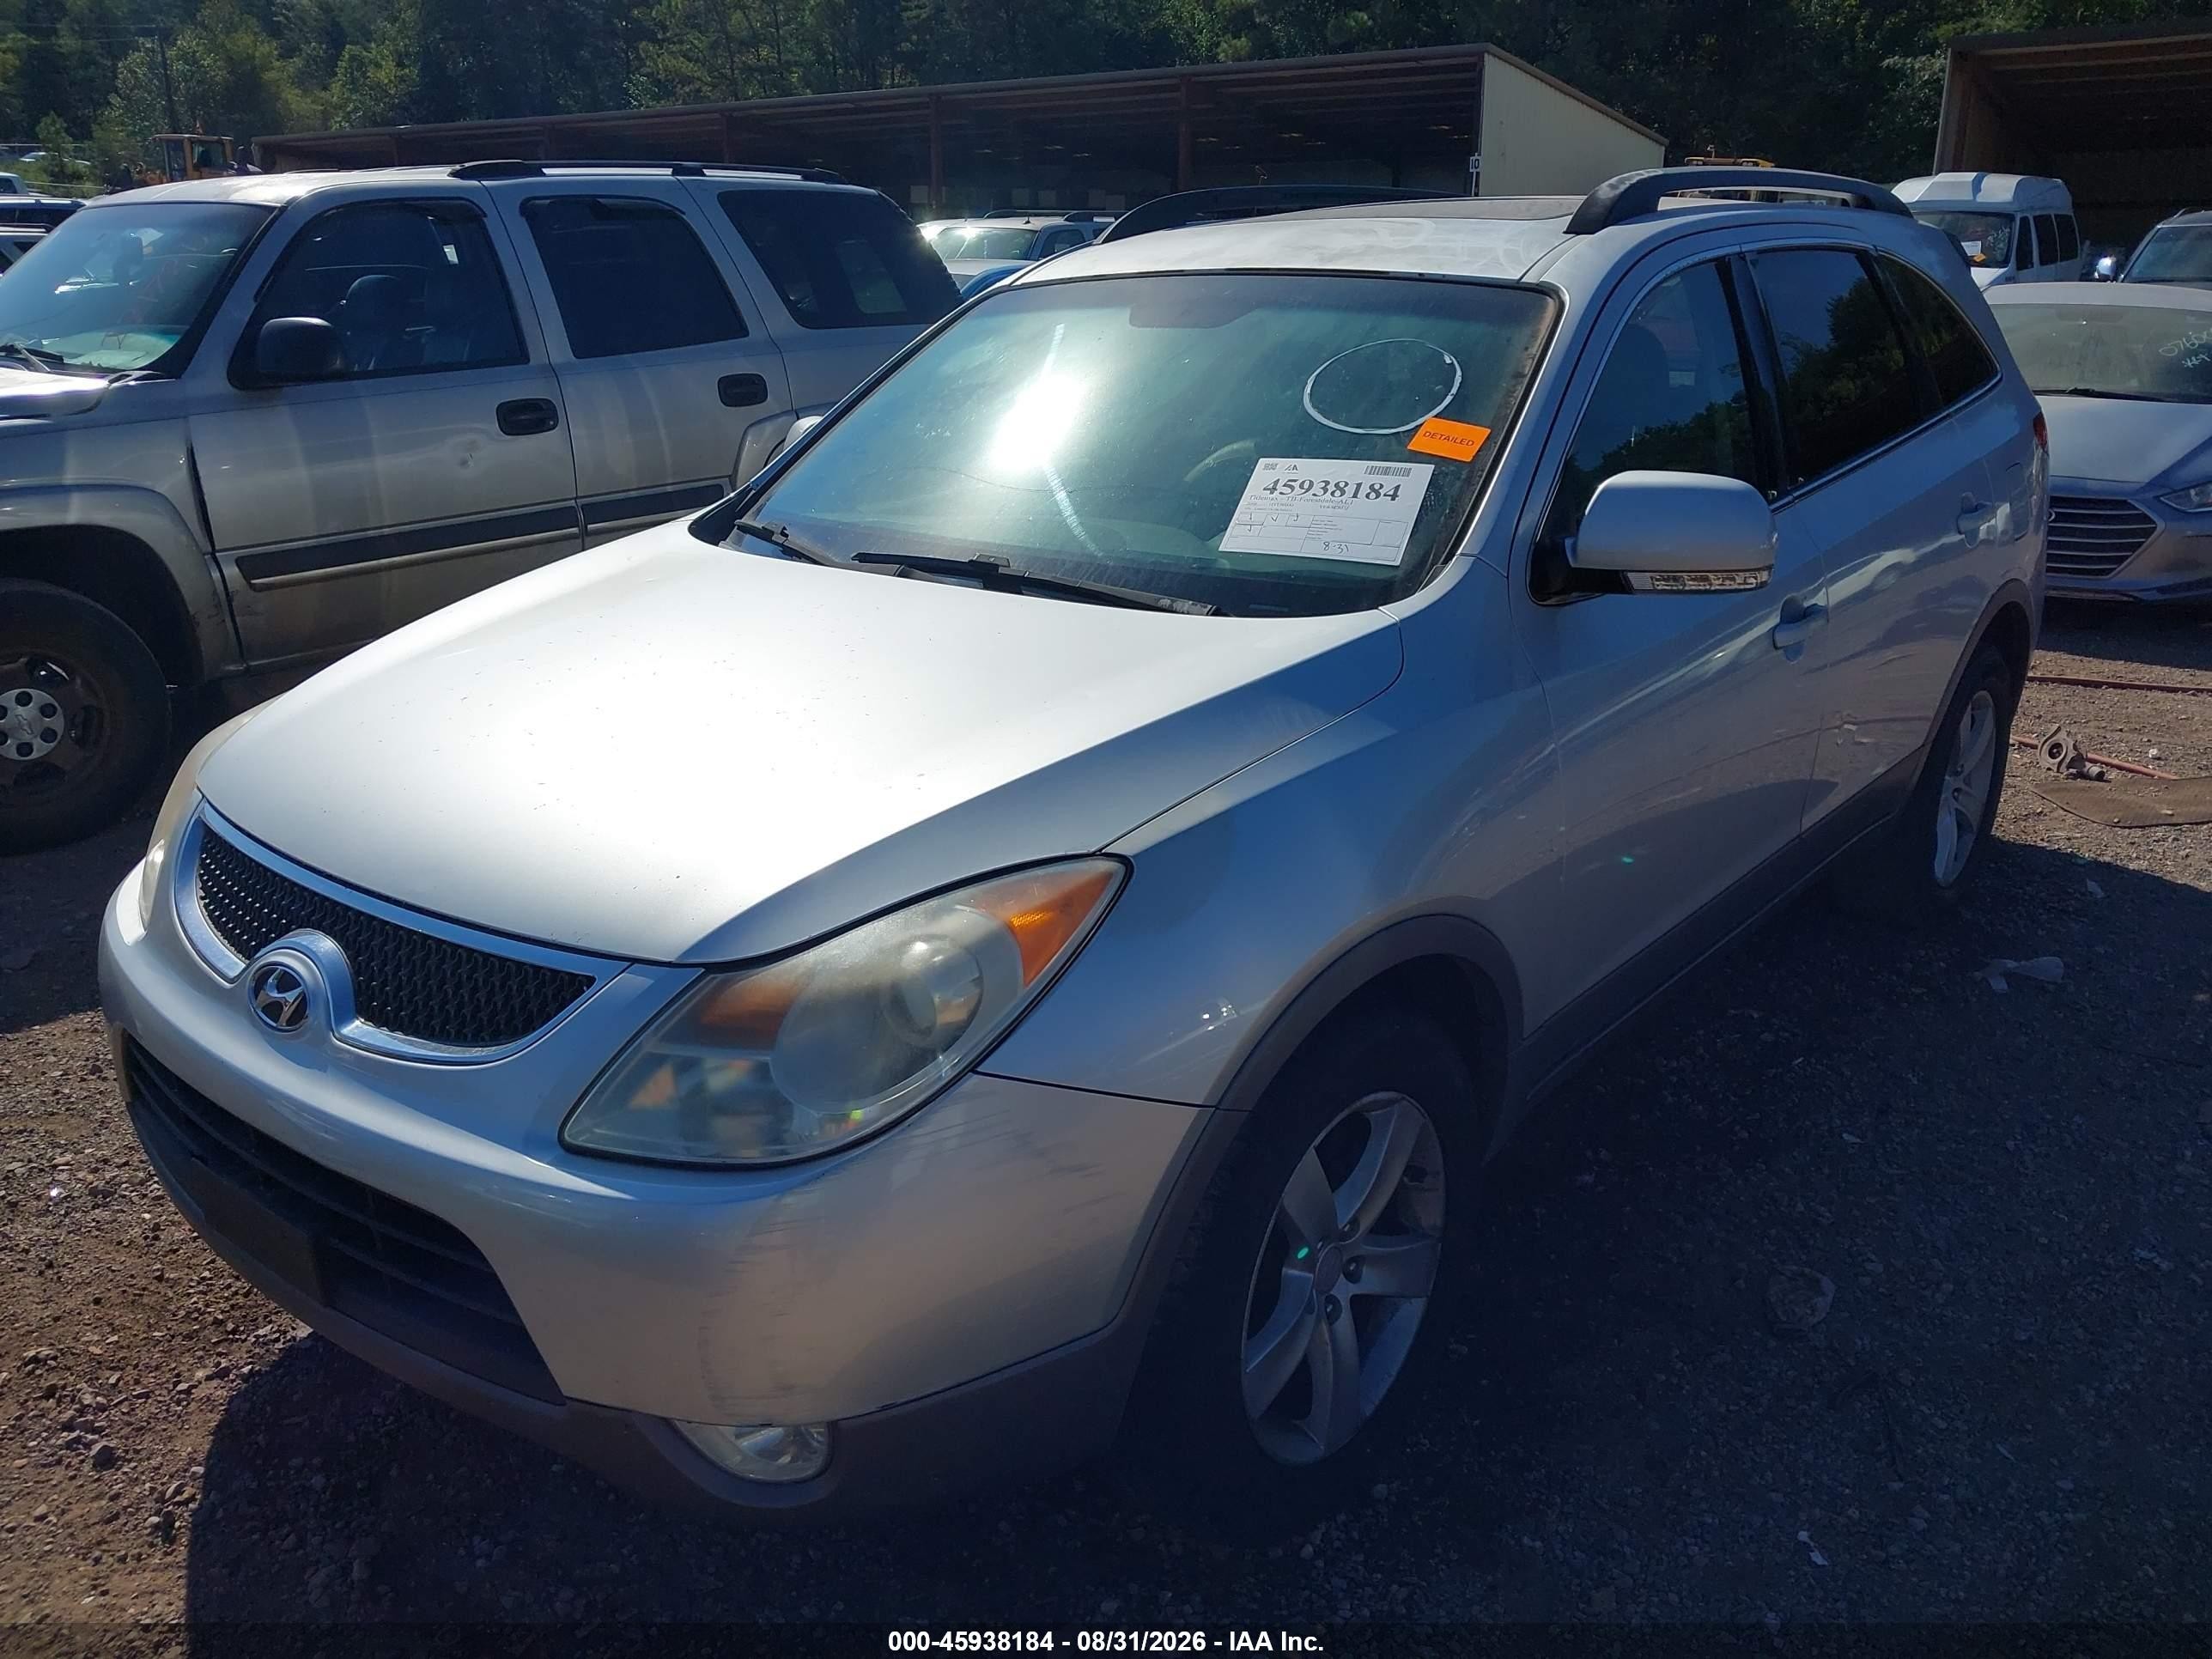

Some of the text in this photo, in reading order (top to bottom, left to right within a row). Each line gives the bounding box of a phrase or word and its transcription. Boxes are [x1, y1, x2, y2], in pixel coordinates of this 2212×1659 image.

[1471, 158, 1480, 169] 10
[1423, 430, 1475, 447] DETAILED
[1262, 477, 1402, 501] 45938184
[1322, 541, 1349, 554] 8-31
